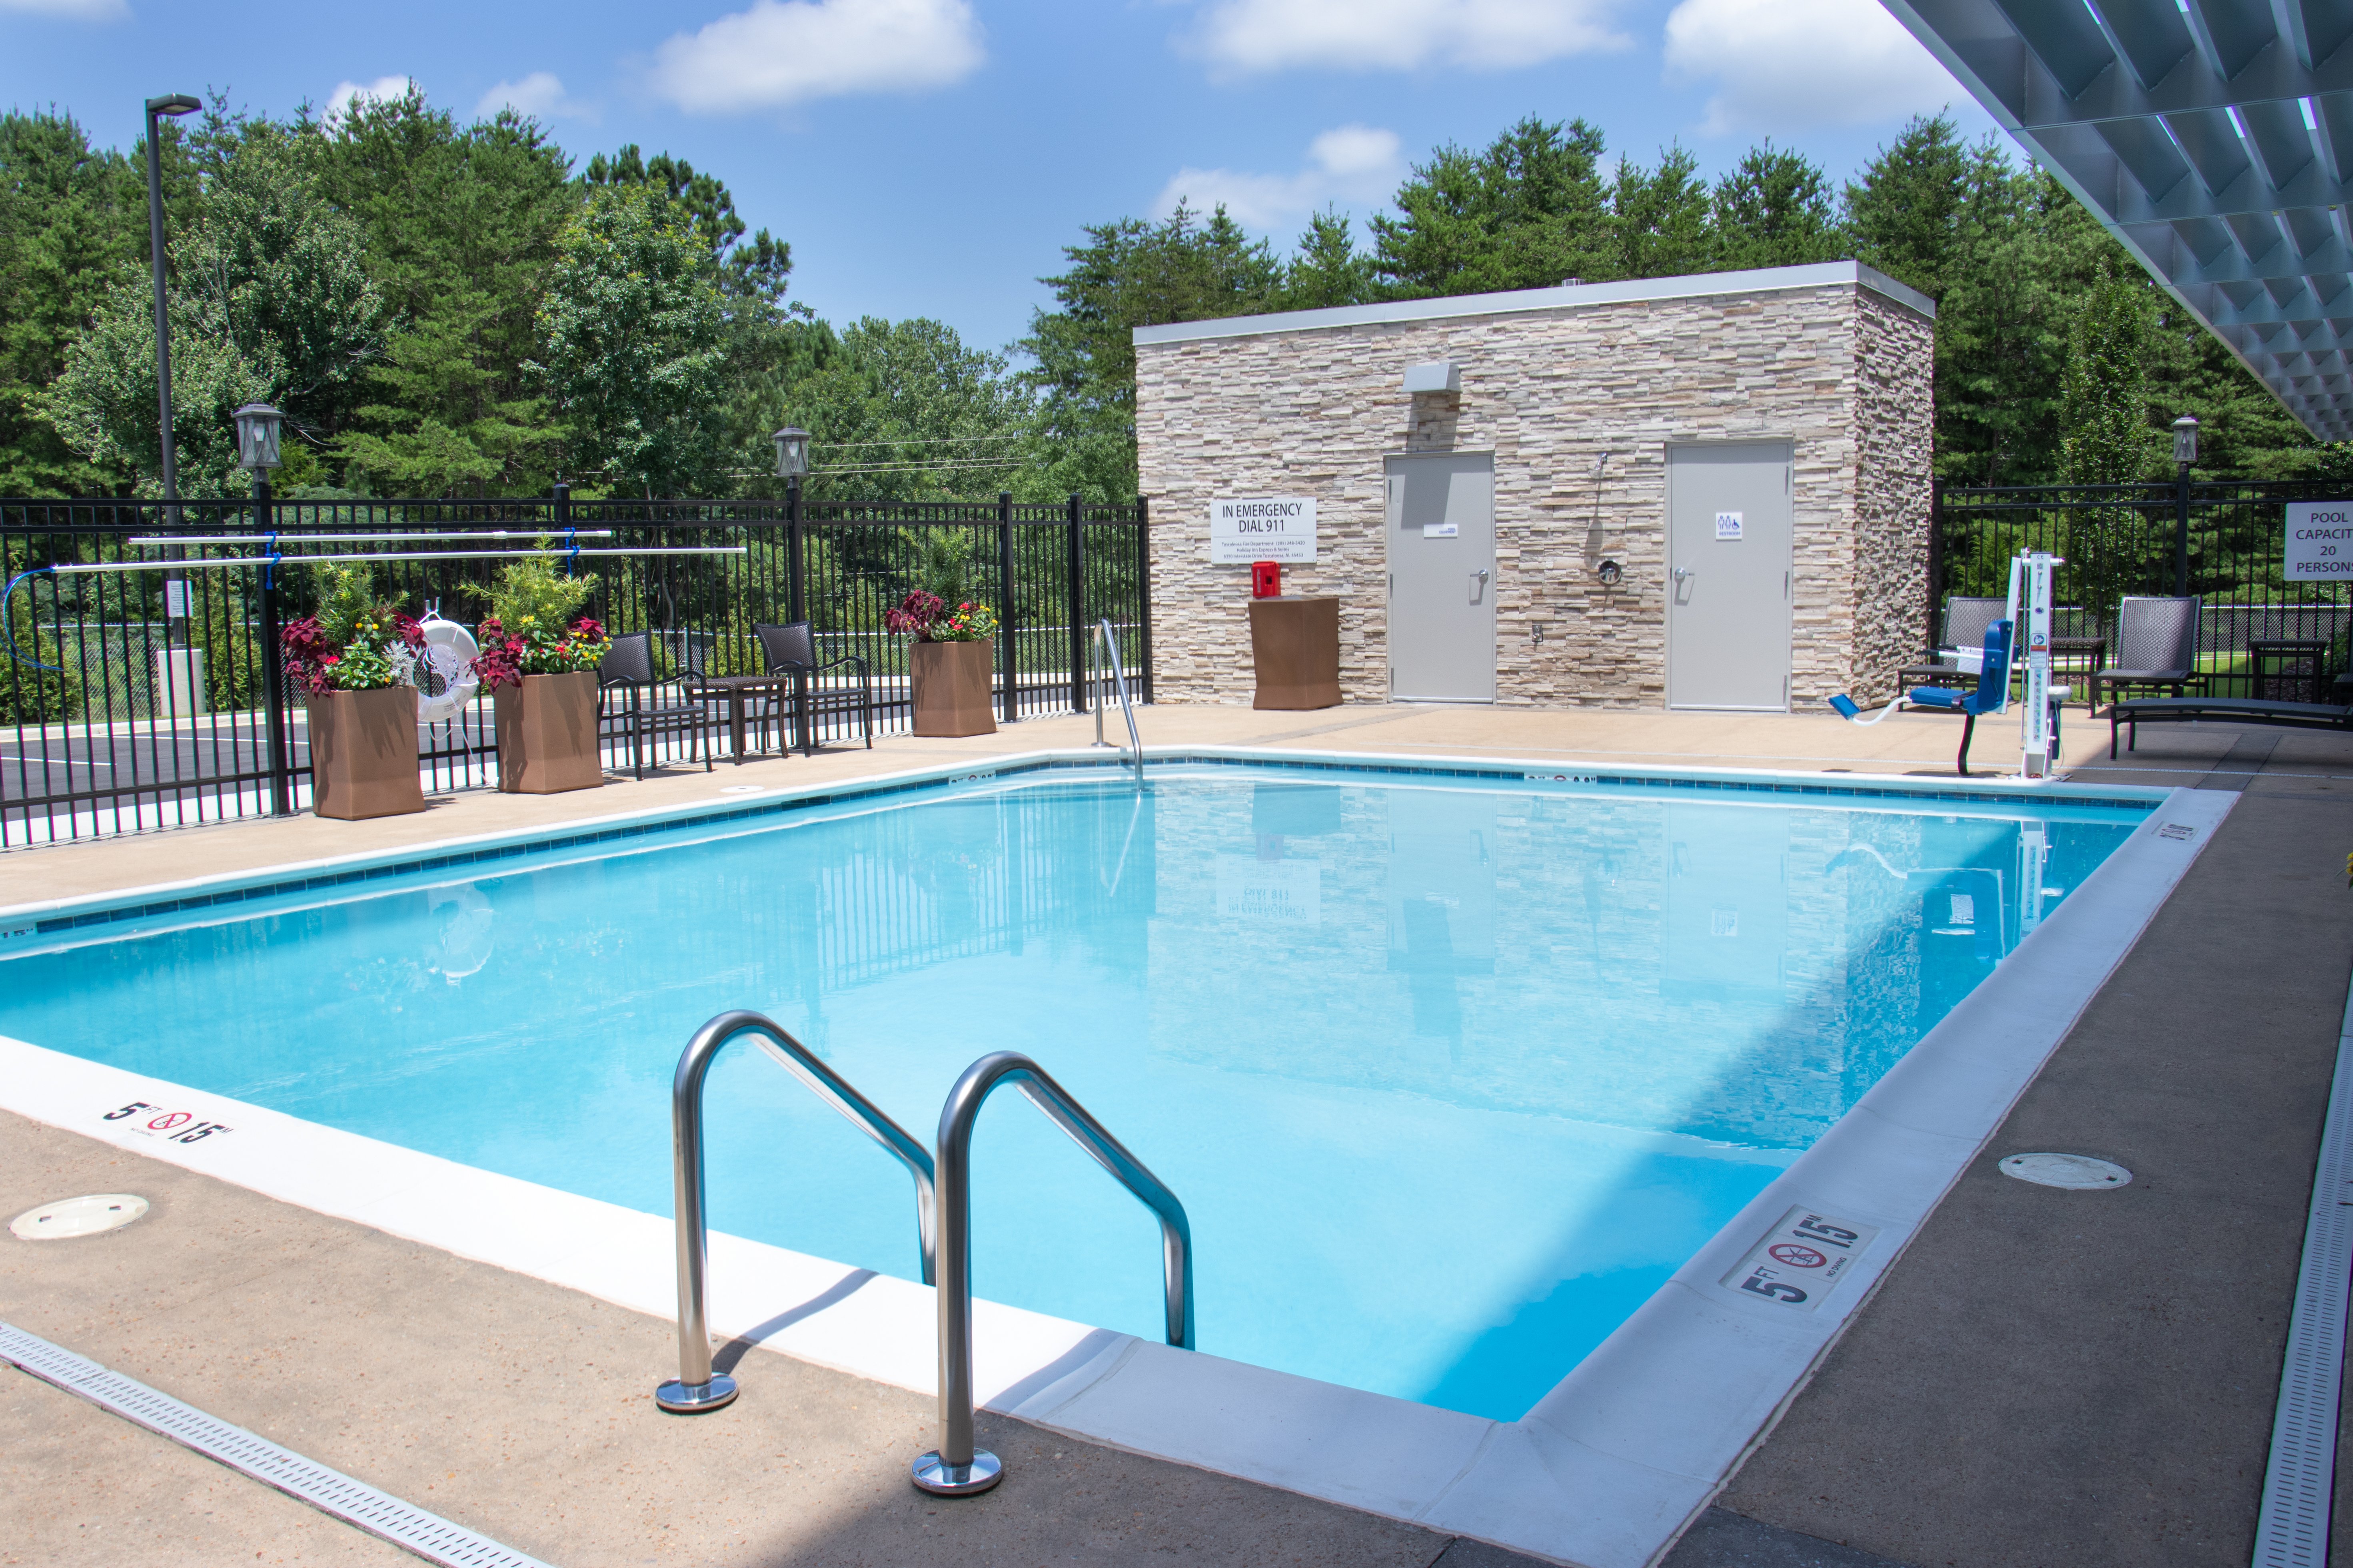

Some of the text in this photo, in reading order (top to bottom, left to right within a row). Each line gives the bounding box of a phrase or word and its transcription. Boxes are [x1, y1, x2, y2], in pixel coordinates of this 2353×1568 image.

[1223, 503, 1302, 518] IN EMERGENCY
[2311, 512, 2348, 523] POOL
[1239, 519, 1284, 533] DIAL 911
[2296, 529, 2353, 540] CAPACIT
[2320, 546, 2336, 556] 20
[2297, 562, 2353, 573] PERSON
[1832, 1257, 1847, 1271] DIVING
